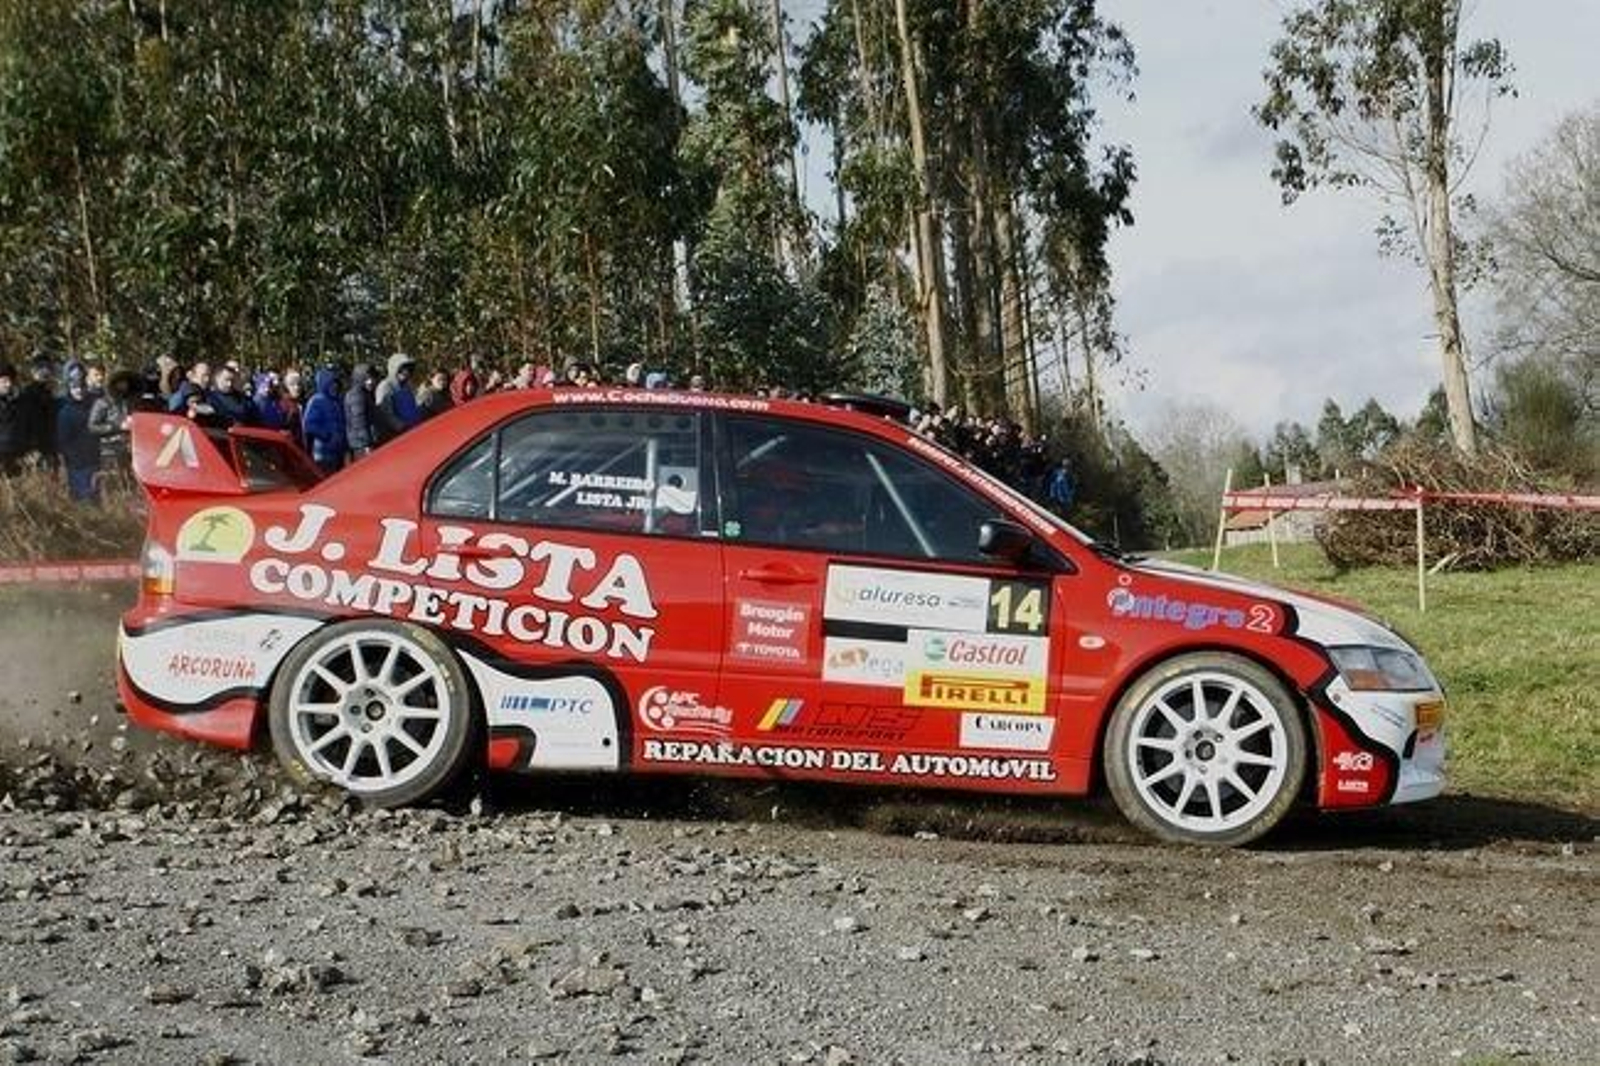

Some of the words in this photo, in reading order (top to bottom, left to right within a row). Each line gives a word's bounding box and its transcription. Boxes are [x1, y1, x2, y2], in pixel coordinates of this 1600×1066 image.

[576, 492, 622, 507] LISTA
[264, 503, 345, 561] J.
[367, 518, 658, 618] LISTA
[249, 558, 655, 662] COMPETICION
[991, 584, 1043, 631] 14
[1246, 604, 1276, 633] 2
[747, 621, 795, 639] Motor
[949, 639, 1028, 666] Castrol
[168, 654, 256, 681] ARCORUÑA
[920, 674, 1030, 704] PIRELLI
[550, 698, 593, 714] PTC
[643, 740, 825, 770] REPARACION
[831, 752, 886, 773] DEL
[891, 756, 1057, 782] AUTOMOVIL
